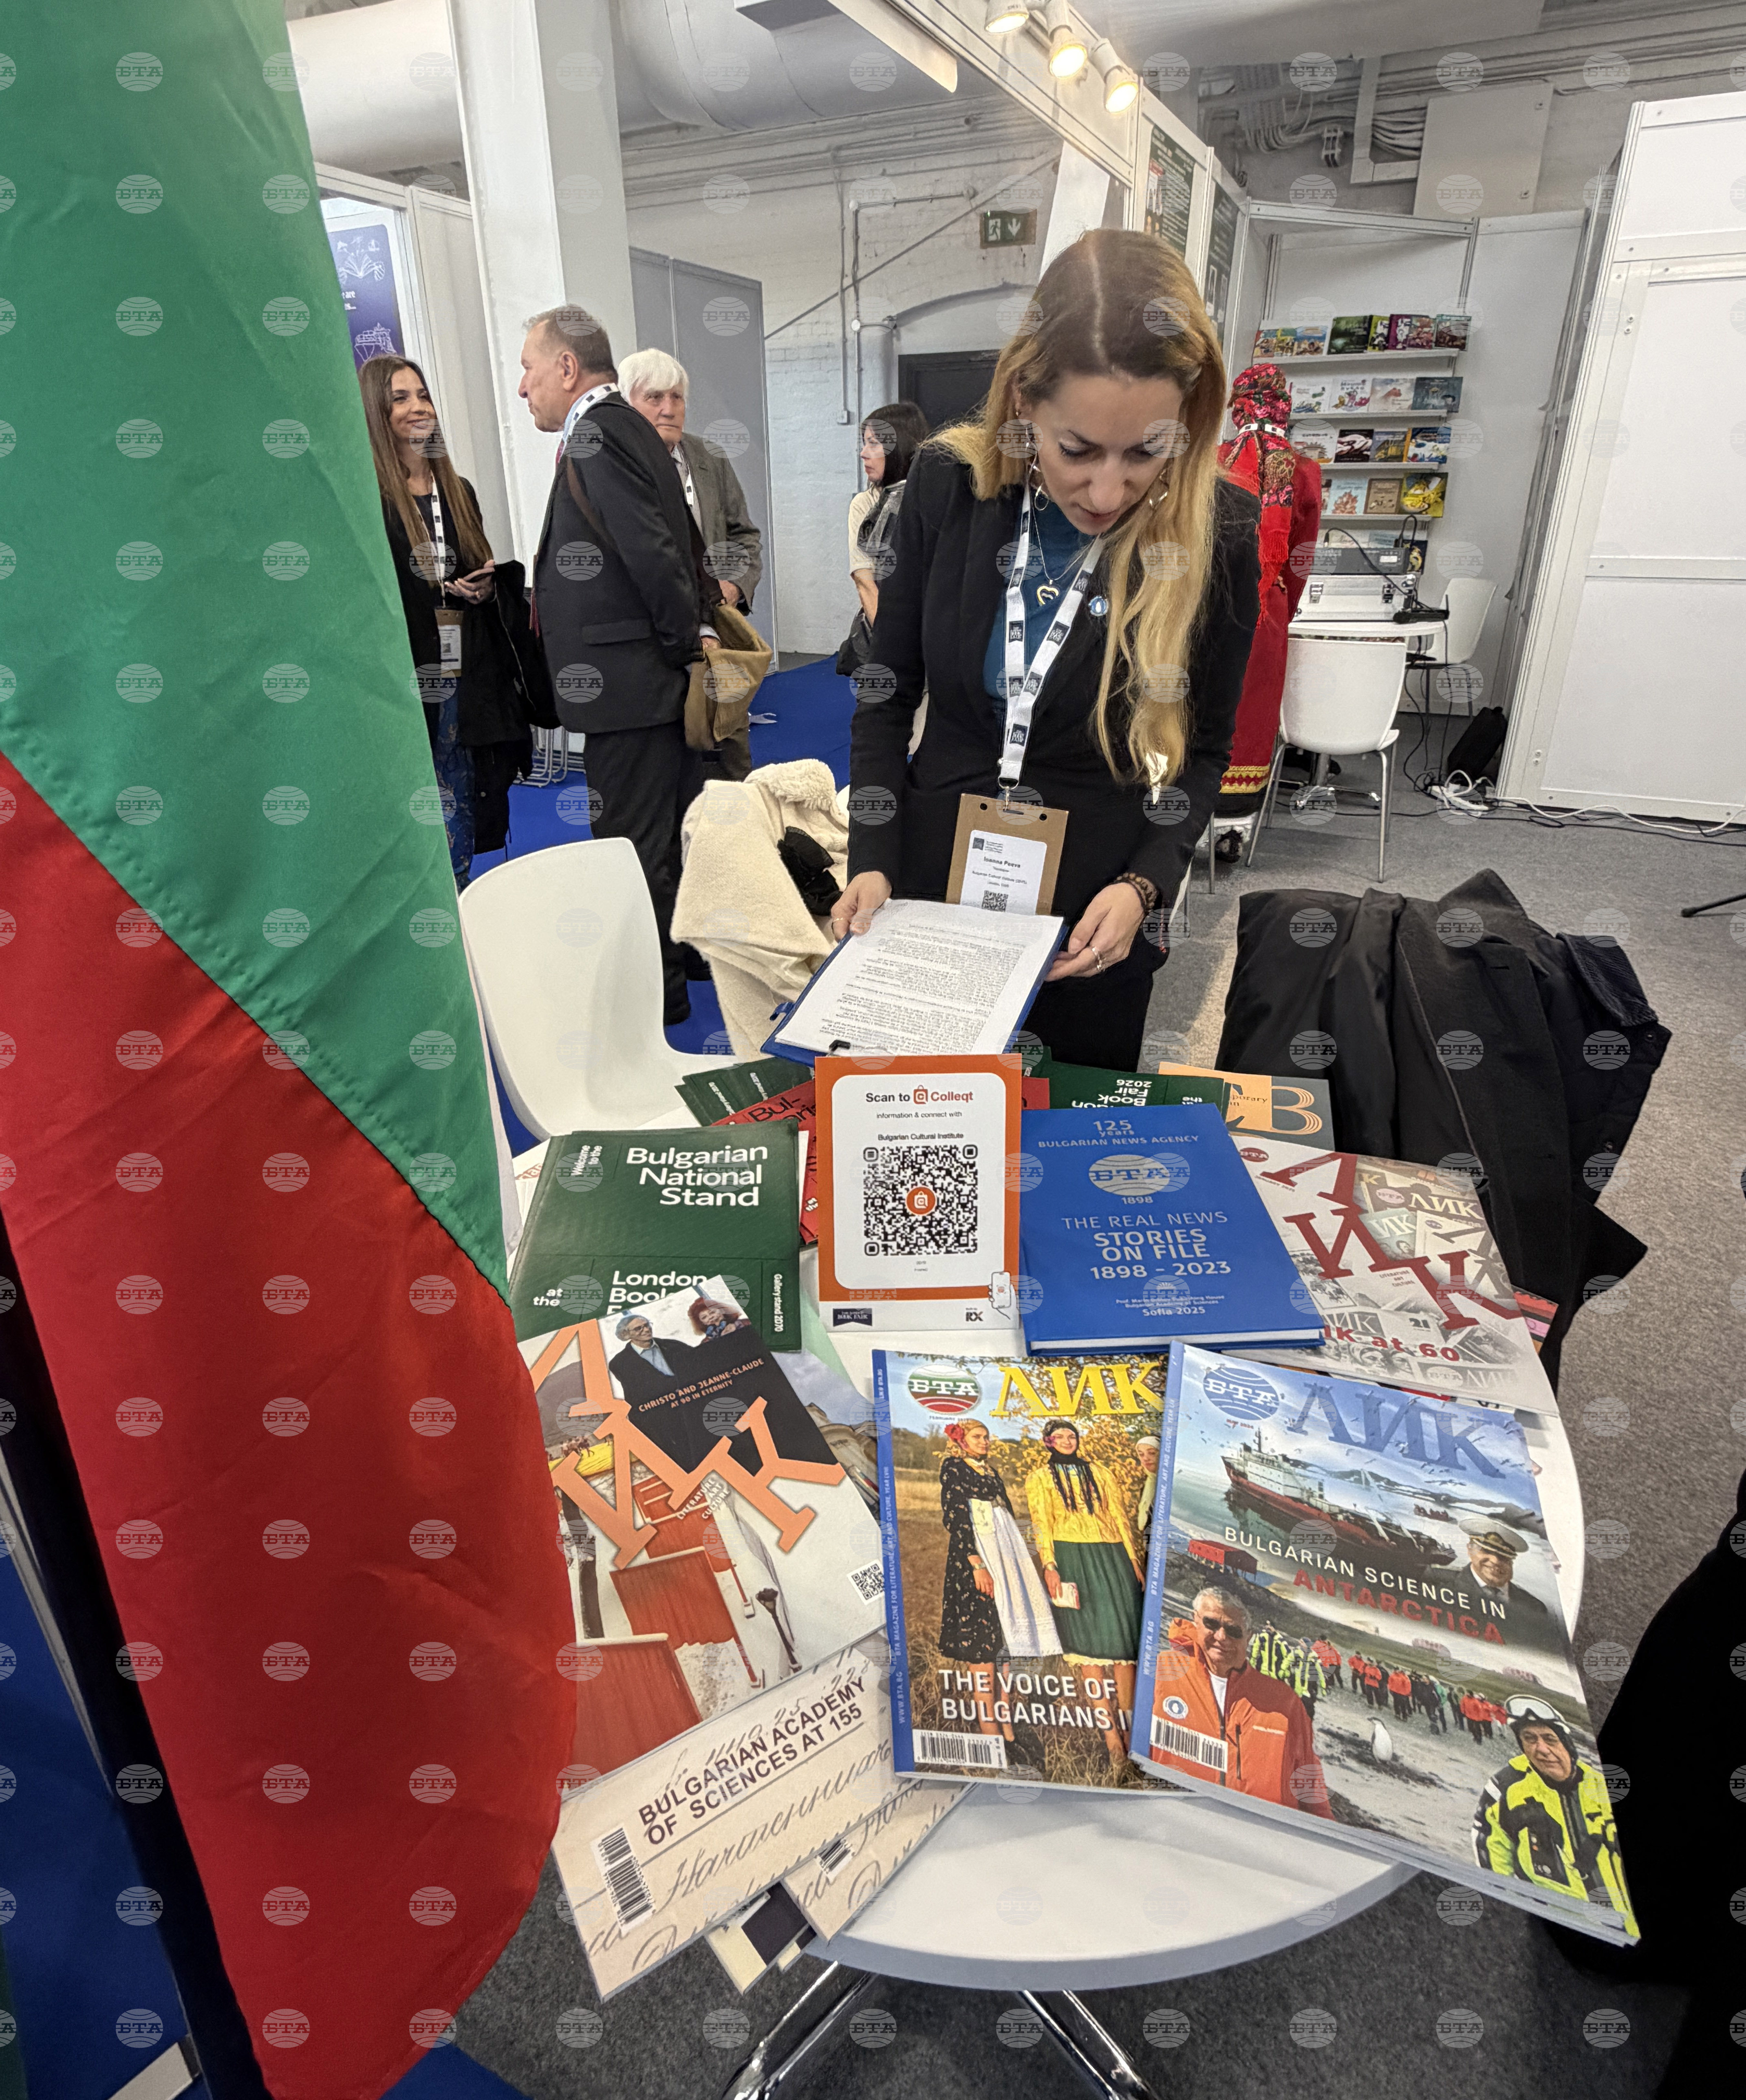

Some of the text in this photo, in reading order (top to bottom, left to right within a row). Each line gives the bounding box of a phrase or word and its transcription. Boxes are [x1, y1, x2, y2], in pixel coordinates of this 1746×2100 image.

[1115, 1087, 1148, 1097] Fair
[1116, 1079, 1153, 1088] 2026
[865, 1091, 974, 1103] Scan to Colleqt
[1098, 1094, 1146, 1107] Book
[1230, 1094, 1268, 1103] porary
[1093, 1120, 1132, 1132] 125
[1099, 1129, 1135, 1138] years
[878, 1134, 909, 1142] Bulgarian
[1038, 1135, 1199, 1148] BULGARIAN NEWS AGENCY
[571, 1145, 591, 1176] Welcome
[590, 1145, 603, 1158] the
[626, 1145, 768, 1169] Bulgarian
[639, 1164, 762, 1186] National
[659, 1186, 759, 1207] Stand
[1122, 1196, 1153, 1205] 1898
[1061, 1211, 1228, 1229] THE REAL NEWS
[1093, 1228, 1207, 1247] STORIES
[1102, 1243, 1210, 1262] ON FILE
[612, 1270, 708, 1286] London
[1090, 1265, 1148, 1279] 1898
[1172, 1261, 1231, 1276] 2023
[533, 1296, 560, 1307] the
[546, 1287, 564, 1297] at
[772, 1273, 783, 1332] Gallery stand 2070
[1142, 1306, 1205, 1316] Sofia 2025
[966, 1311, 984, 1321] RX
[1371, 1336, 1405, 1352] at
[1419, 1343, 1460, 1362] 60
[638, 1358, 765, 1412] CHRISTO AND JEANNE-CLAUDE
[701, 1379, 733, 1396] ETERNITY
[908, 1379, 979, 1396] БТА
[989, 1362, 1166, 1417] ЛИК
[1204, 1378, 1276, 1405] БТА
[1286, 1382, 1506, 1479] ЛИК
[677, 1478, 715, 1520] LITERATURE
[708, 1483, 721, 1498] ART
[701, 1488, 730, 1519] CULTURE
[1153, 1541, 1161, 1579] MAGAZINE
[1224, 1526, 1506, 1620] BULGARIAN SCIENCE IN
[1293, 1568, 1505, 1646] ANTARCTICA
[1143, 1620, 1155, 1675] WWW.BTA.BG
[938, 1670, 1116, 1700] THE VOICE OF
[896, 1671, 906, 1724] WWW.BTA.BG
[942, 1698, 1111, 1730] BULGARIANS
[638, 1676, 866, 1825] BULGARIAN ACADEMY
[648, 1702, 862, 1845] OF SCIENCES AT 155
